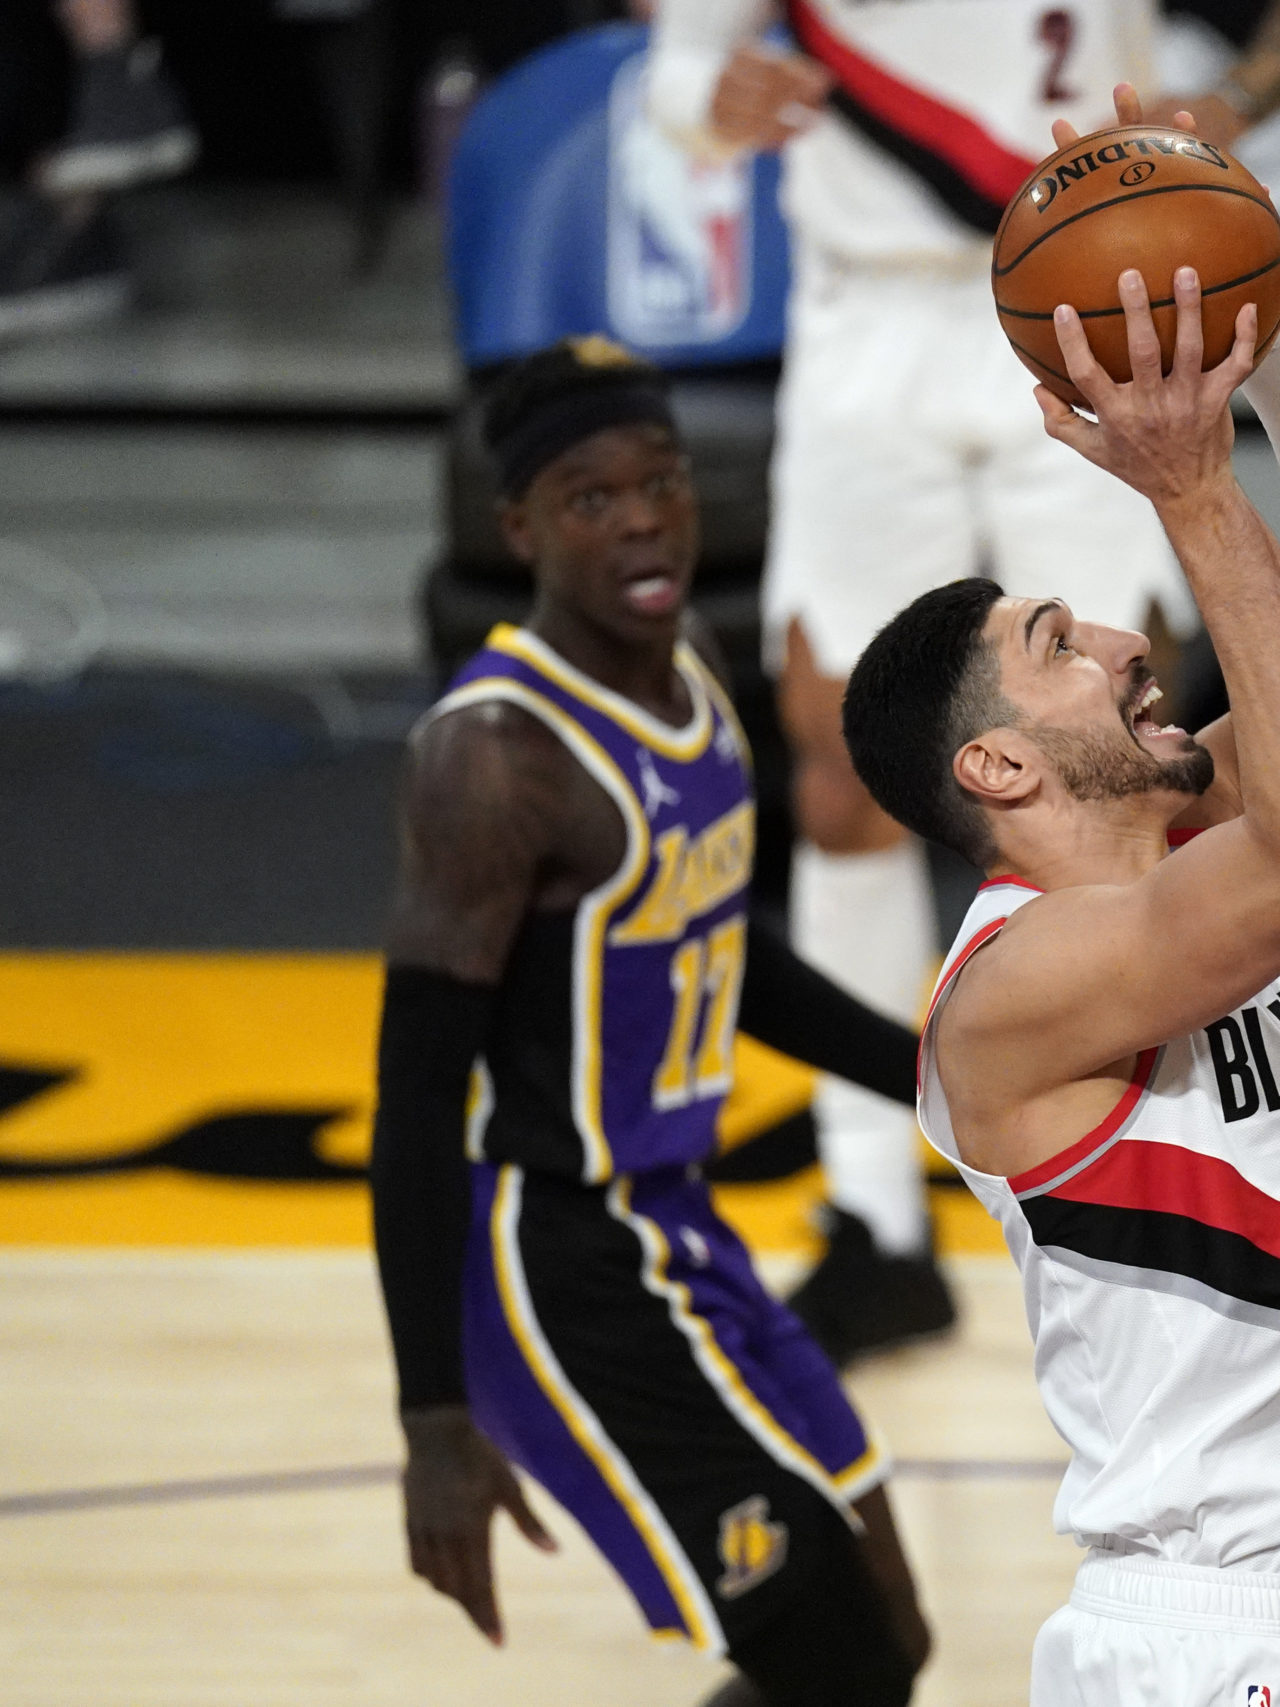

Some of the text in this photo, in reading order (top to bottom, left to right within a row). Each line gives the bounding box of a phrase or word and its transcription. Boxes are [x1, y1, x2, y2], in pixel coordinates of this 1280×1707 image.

[1034, 8, 1080, 105] 2
[1028, 137, 1229, 214] SPALDING
[651, 916, 747, 1112] 17
